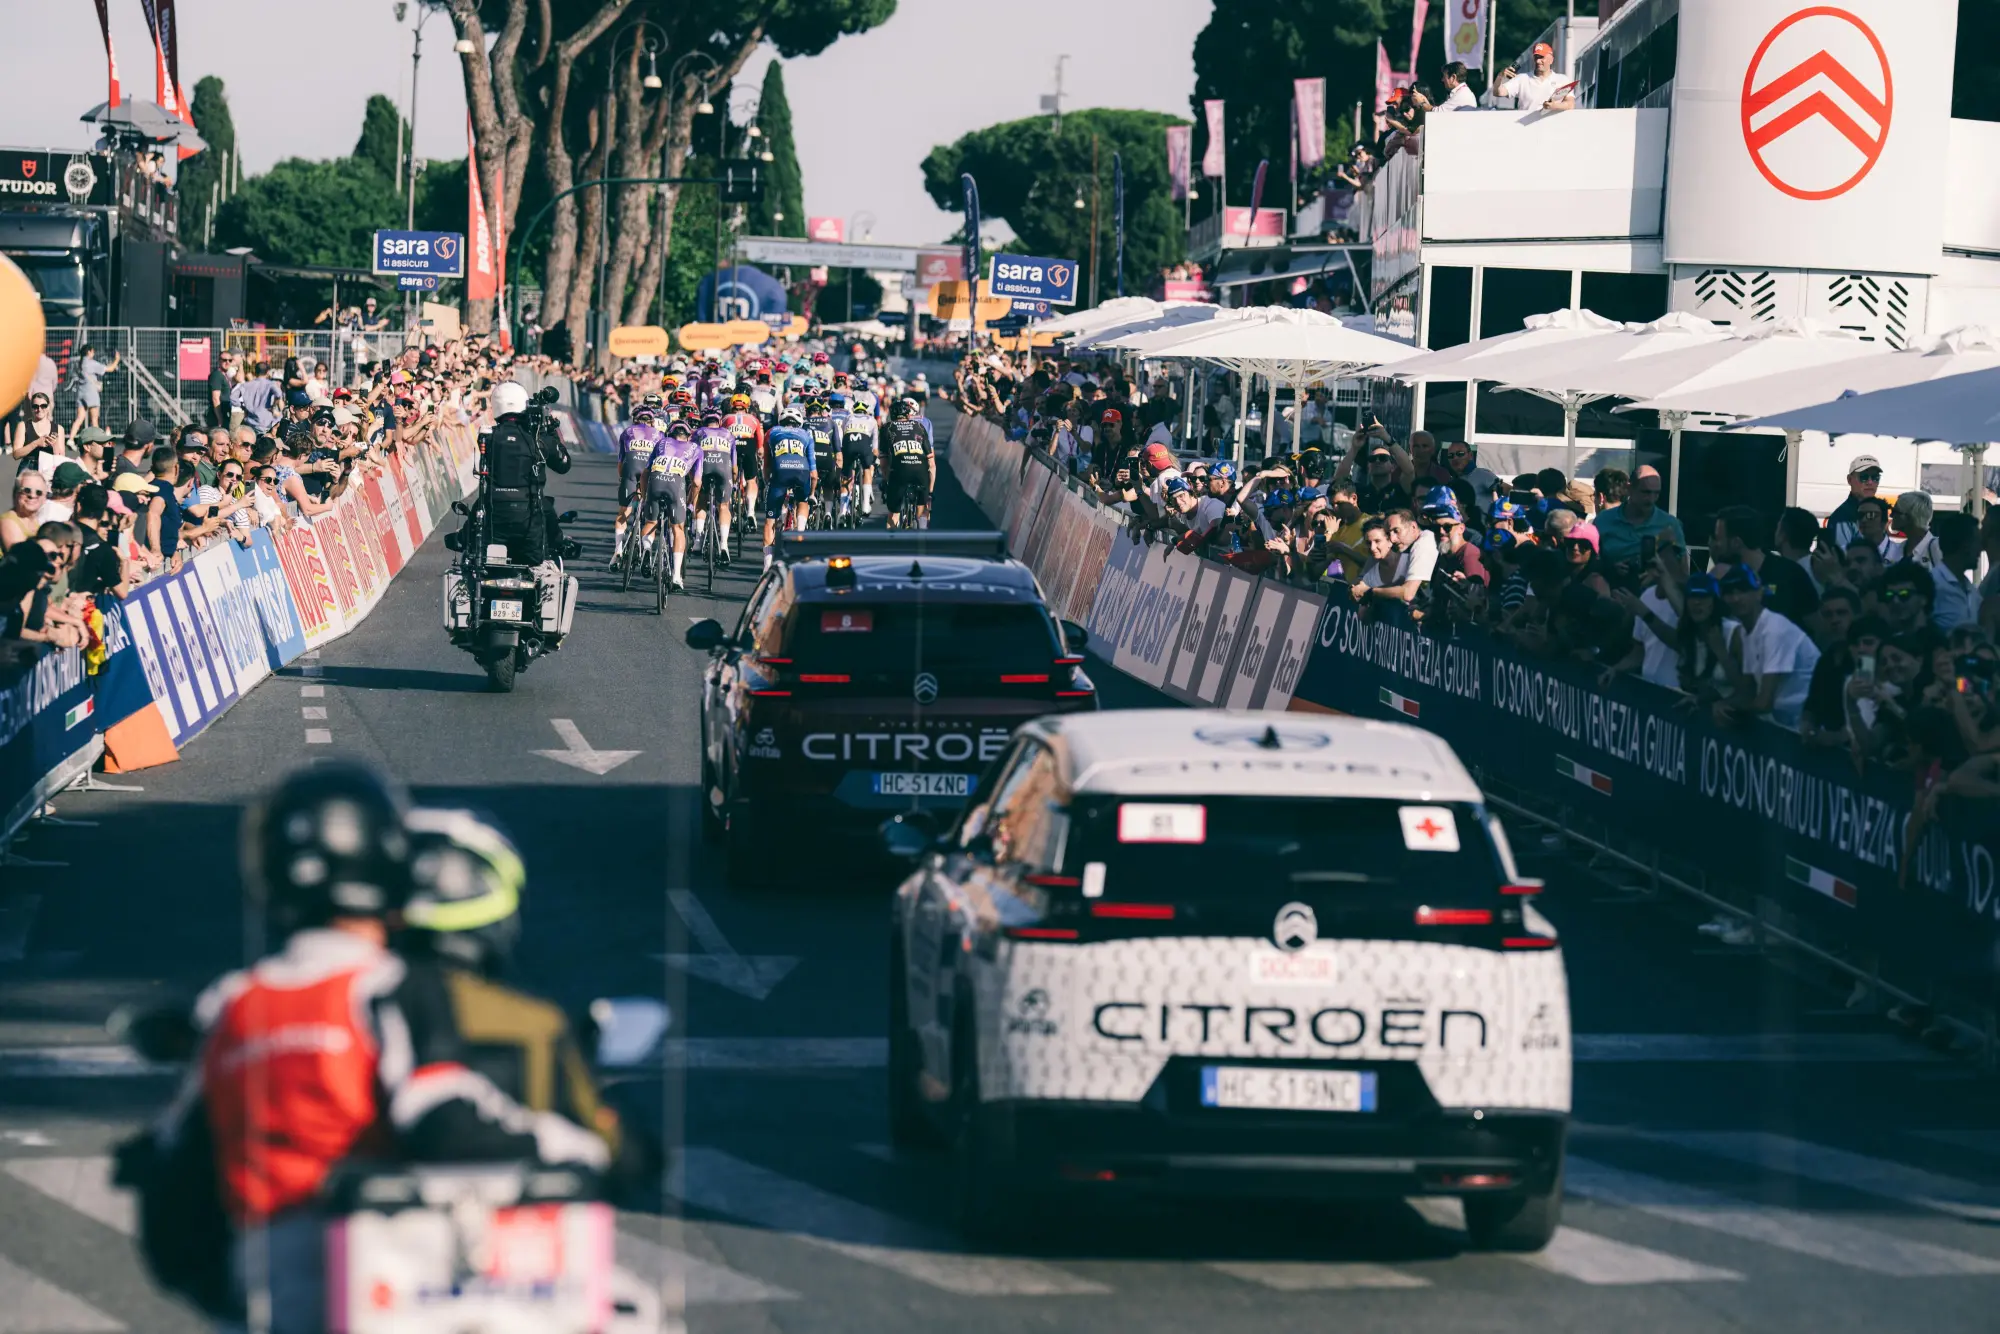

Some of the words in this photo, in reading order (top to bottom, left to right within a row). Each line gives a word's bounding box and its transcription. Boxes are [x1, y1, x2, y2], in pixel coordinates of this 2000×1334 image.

[0, 180, 57, 195] TUDOR
[382, 238, 429, 256] sara
[382, 258, 391, 268] ti
[391, 259, 429, 268] assicura
[997, 262, 1043, 282] sara
[400, 276, 423, 287] sara
[996, 282, 1004, 292] ti
[1004, 283, 1042, 295] assicura
[1012, 300, 1035, 311] sara
[673, 459, 687, 470] 146
[1182, 602, 1210, 655] Rai
[1209, 615, 1239, 667] Rai
[1315, 604, 1341, 648] IO
[1339, 609, 1374, 662] SONO
[1374, 621, 1400, 673] FRIULI
[1399, 629, 1441, 689] VENEZIA
[1443, 644, 1481, 701] GIULIA
[1240, 628, 1272, 681] Rai
[1272, 639, 1306, 695] Rai
[1493, 657, 1507, 709] IO
[1508, 661, 1545, 724] SONO
[1546, 676, 1581, 741] FRIULI
[1582, 689, 1640, 765] VENEZIA
[1643, 713, 1686, 786] GIULIA
[802, 728, 1011, 761] CITROË
[883, 776, 904, 792] HC
[910, 776, 967, 795] 514NC
[1700, 736, 1719, 798] IO
[1721, 744, 1778, 819] SONO
[1777, 764, 1824, 840] FRIULI
[1828, 781, 1897, 873] VENEZIA
[1222, 1079, 1254, 1100] HC
[1267, 1081, 1354, 1107] 519NC
